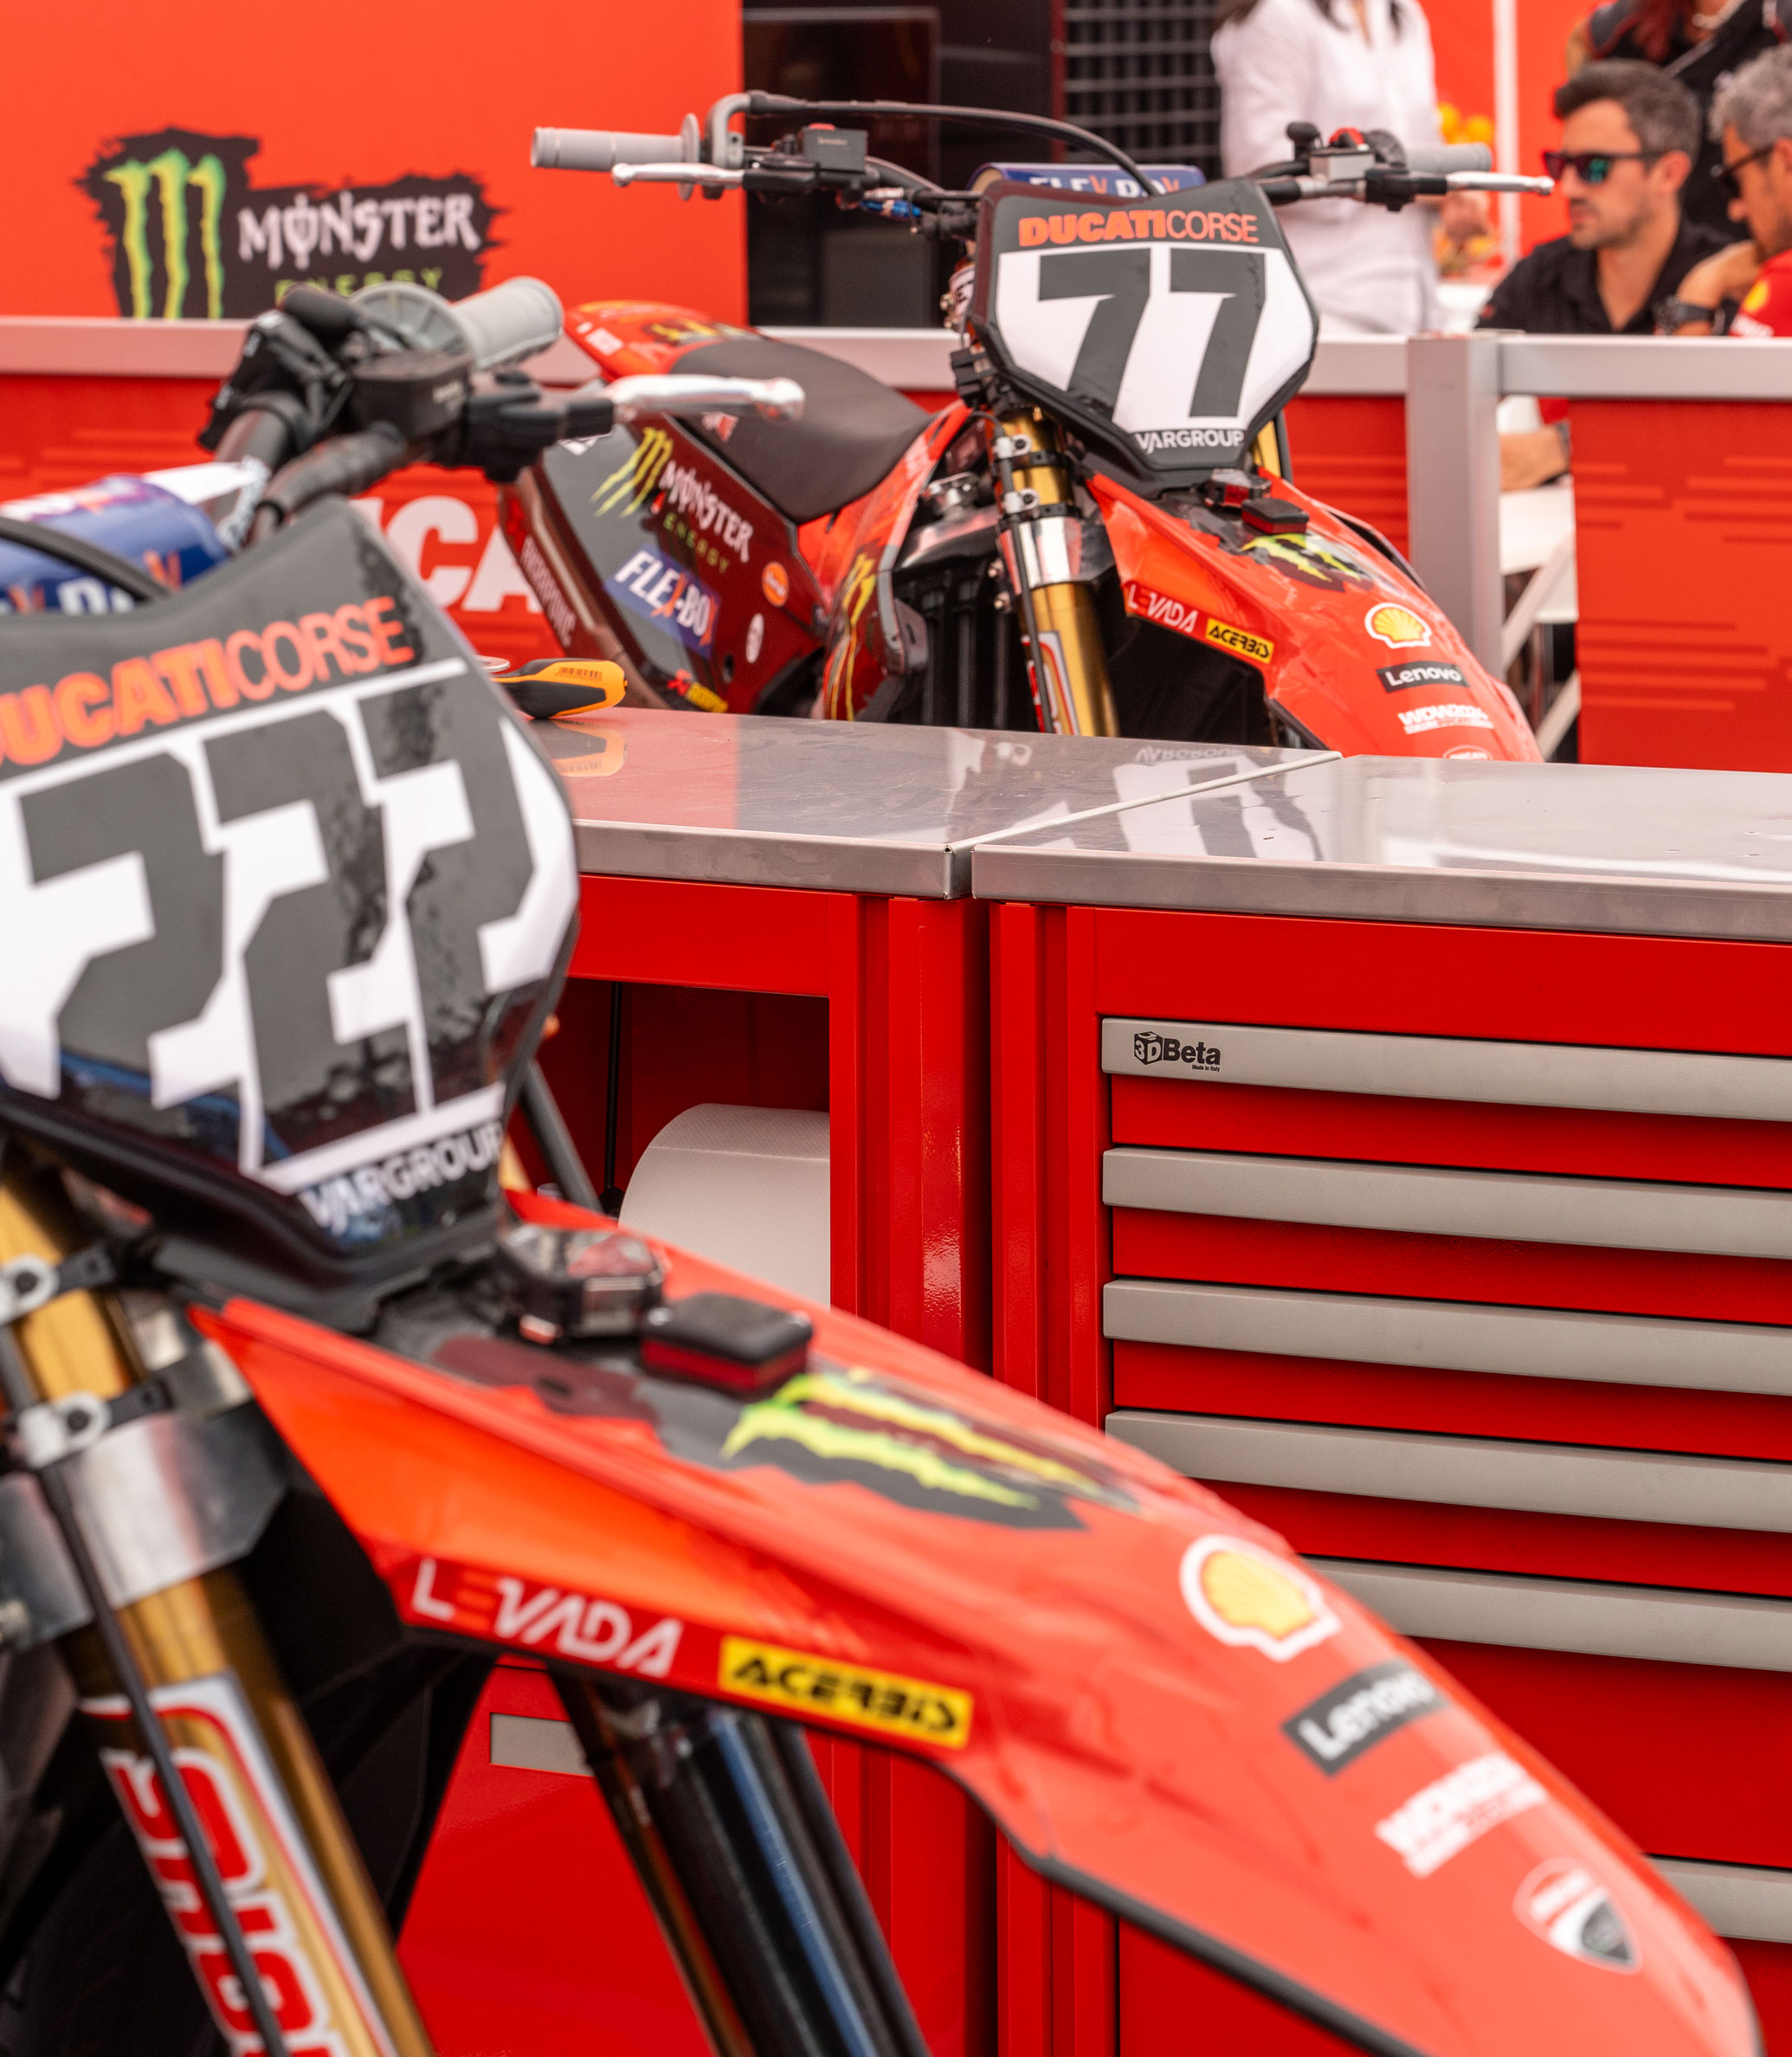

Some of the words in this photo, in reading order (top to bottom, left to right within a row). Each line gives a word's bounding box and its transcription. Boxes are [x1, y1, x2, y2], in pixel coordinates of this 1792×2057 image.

[1038, 248, 1267, 424] 77
[1135, 429, 1245, 455] VARGROUP
[1385, 665, 1462, 687] Lenovo
[18, 690, 537, 1164] 222
